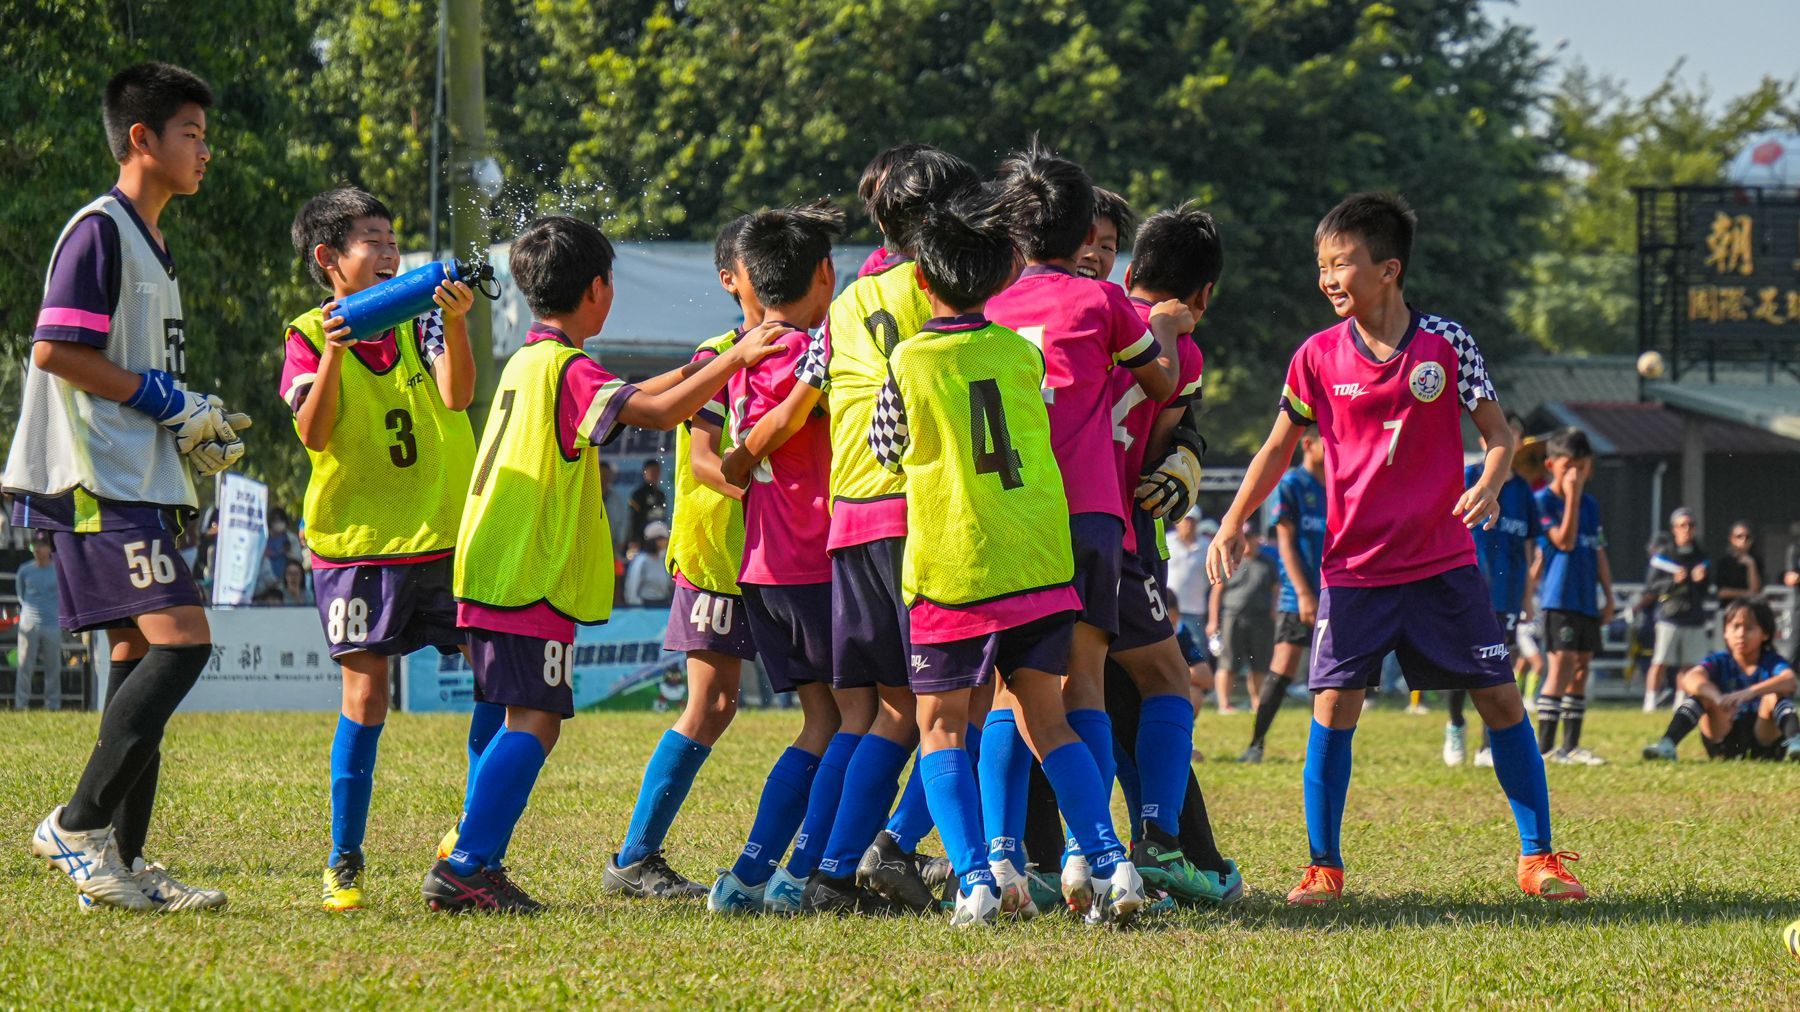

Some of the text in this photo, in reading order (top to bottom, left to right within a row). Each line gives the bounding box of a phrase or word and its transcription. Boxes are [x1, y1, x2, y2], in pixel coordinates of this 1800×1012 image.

[385, 408, 418, 468] 3
[968, 378, 1025, 490] 4
[1383, 419, 1403, 466] 7
[123, 539, 176, 588] 56
[328, 598, 368, 644] 88
[690, 592, 733, 635] 40
[1143, 575, 1169, 622] 5
[209, 643, 262, 671] 育部
[1314, 618, 1329, 667] 7
